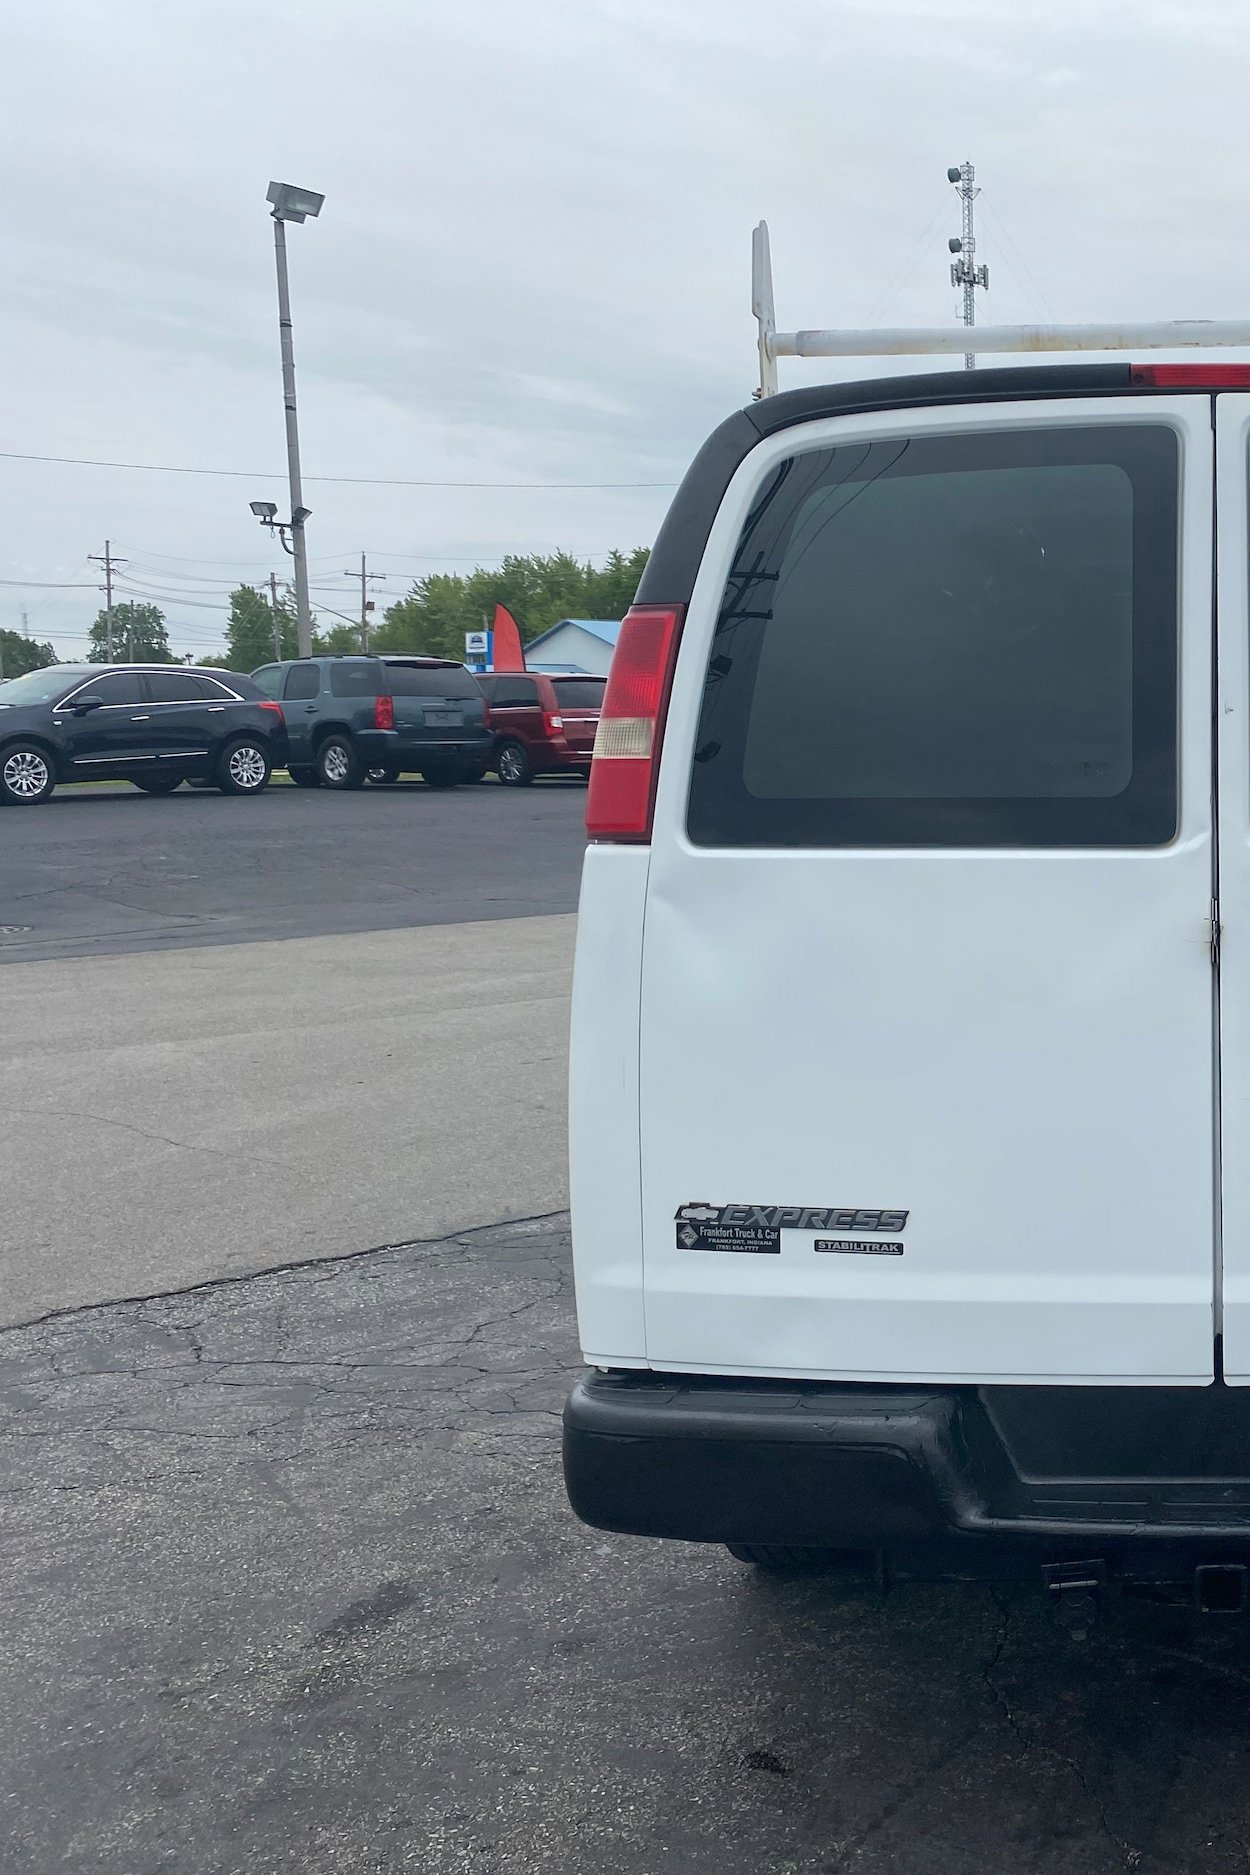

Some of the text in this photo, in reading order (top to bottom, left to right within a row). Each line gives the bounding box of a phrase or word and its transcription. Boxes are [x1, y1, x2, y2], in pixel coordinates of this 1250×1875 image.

[720, 1206, 907, 1232] EXPRESS
[700, 1226, 733, 1238] Frankfort
[734, 1228, 756, 1239] Truck
[757, 1229, 764, 1239] &
[765, 1229, 779, 1240] Car
[818, 1241, 899, 1252] STABILITRAK
